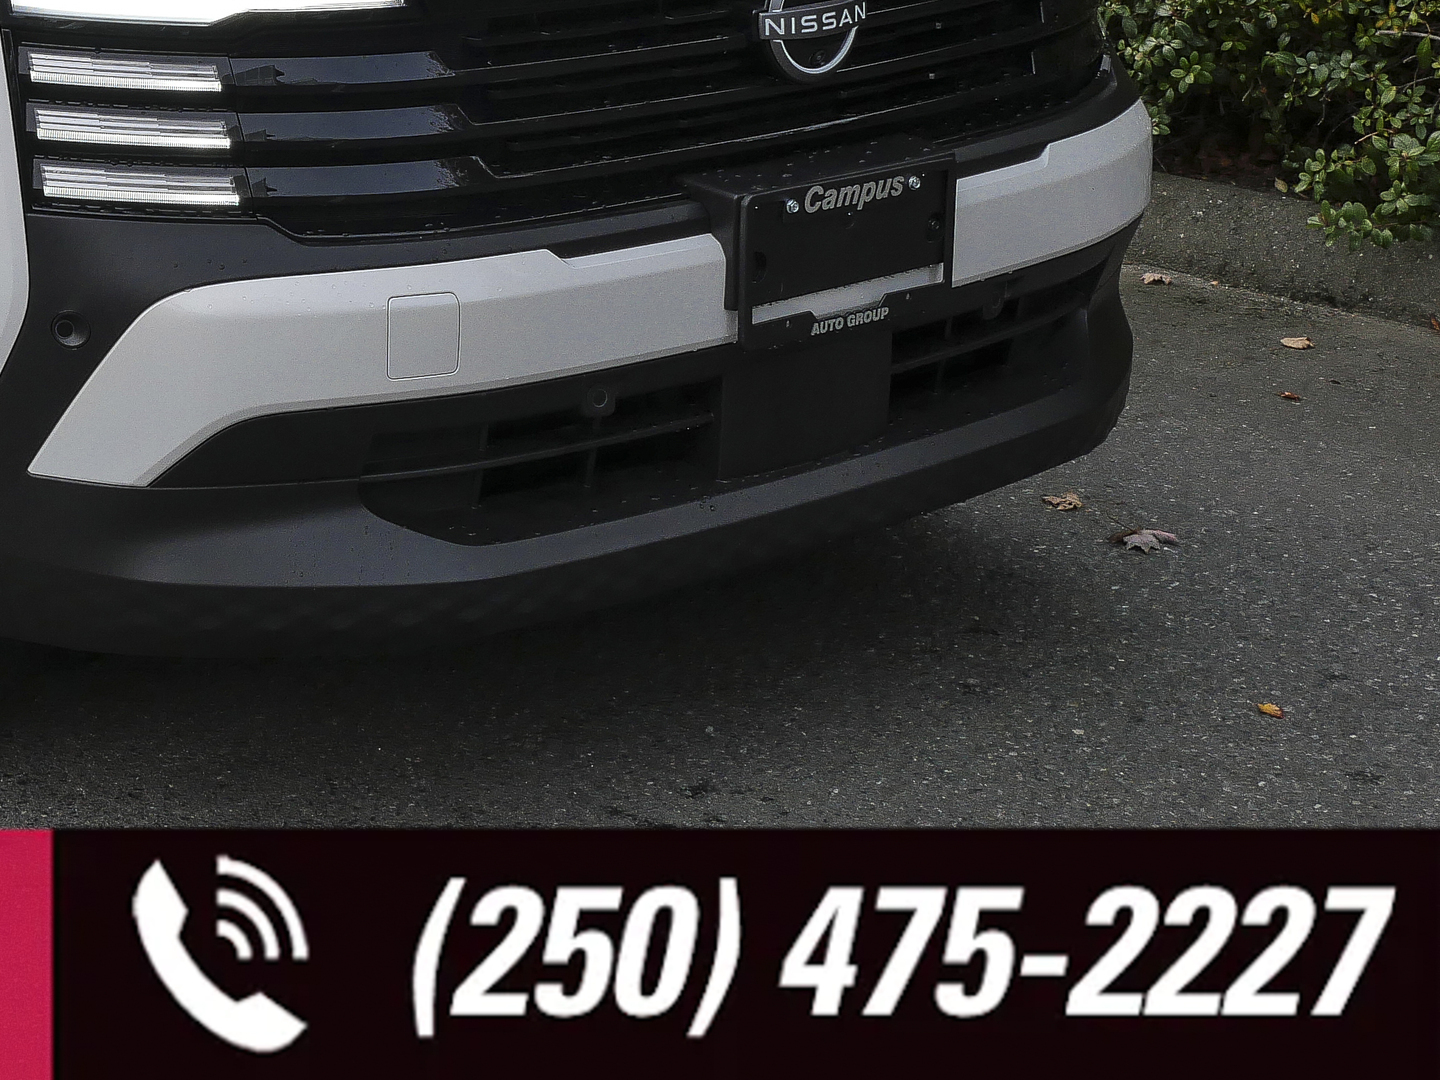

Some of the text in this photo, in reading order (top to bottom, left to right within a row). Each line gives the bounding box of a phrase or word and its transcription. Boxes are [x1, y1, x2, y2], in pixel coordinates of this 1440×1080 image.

[764, 1, 867, 37] NISSAN
[804, 175, 905, 214] Campus
[810, 306, 890, 336] AUTO GROUP
